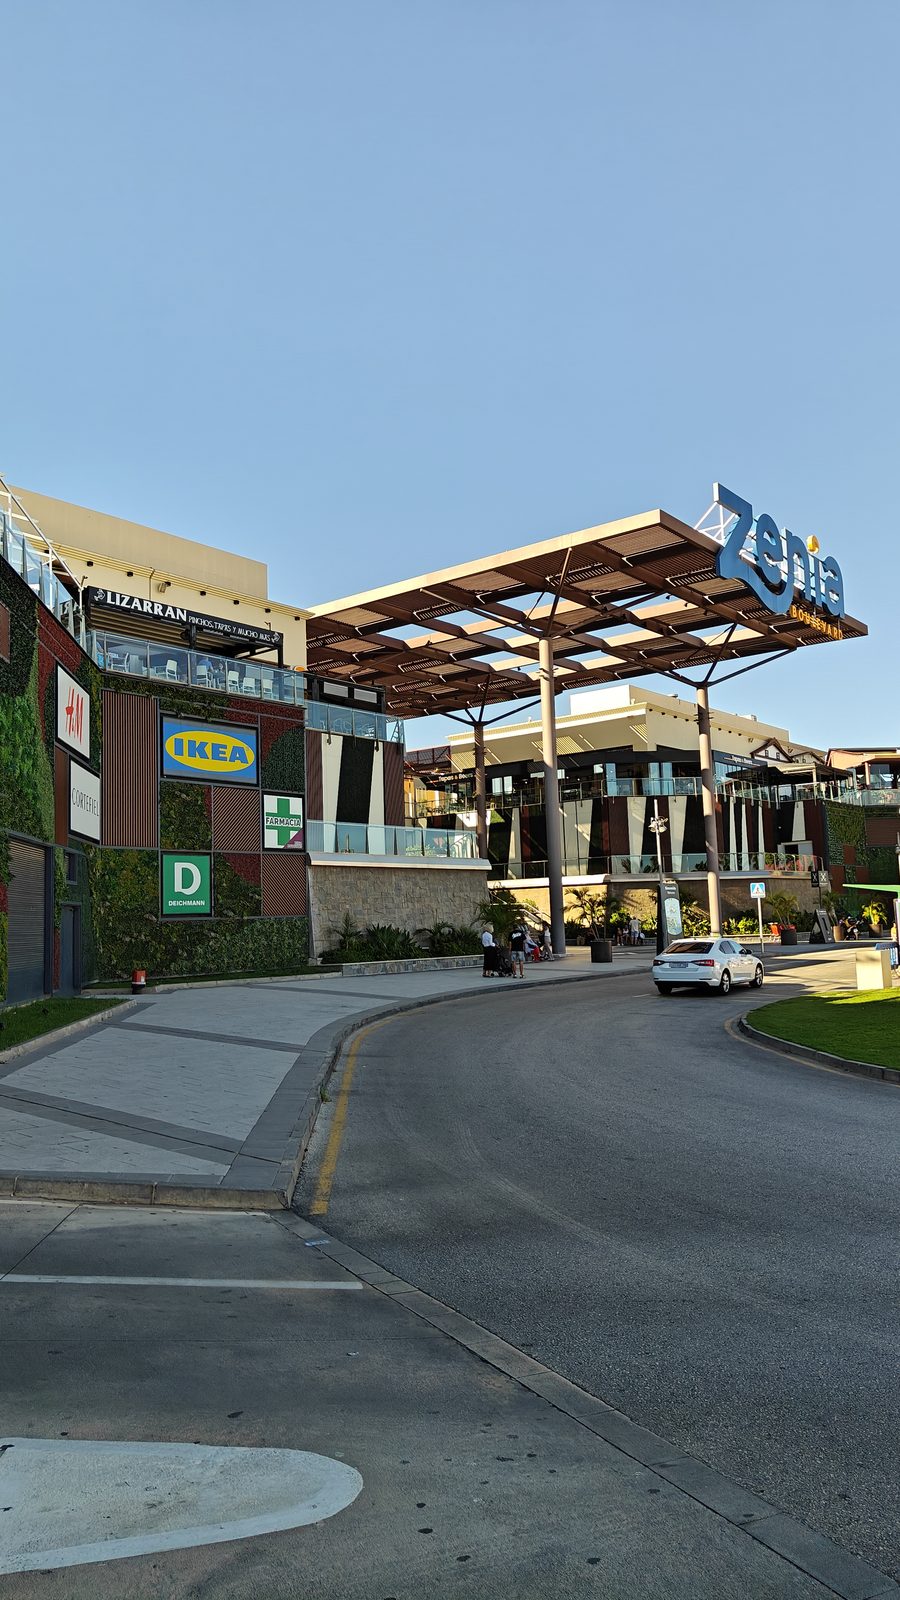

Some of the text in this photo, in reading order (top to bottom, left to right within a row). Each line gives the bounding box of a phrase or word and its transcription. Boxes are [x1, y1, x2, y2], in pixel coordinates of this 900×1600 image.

[713, 482, 845, 620] Zenia
[106, 591, 187, 622] LIZARRAN
[238, 628, 258, 639] MUCHO
[790, 605, 843, 640] BOULEVARD
[65, 686, 84, 745] H&M
[173, 737, 249, 765] IKEA
[72, 788, 99, 817] CORTEFIEL
[265, 817, 302, 827] FARMACIA
[174, 862, 202, 895] D
